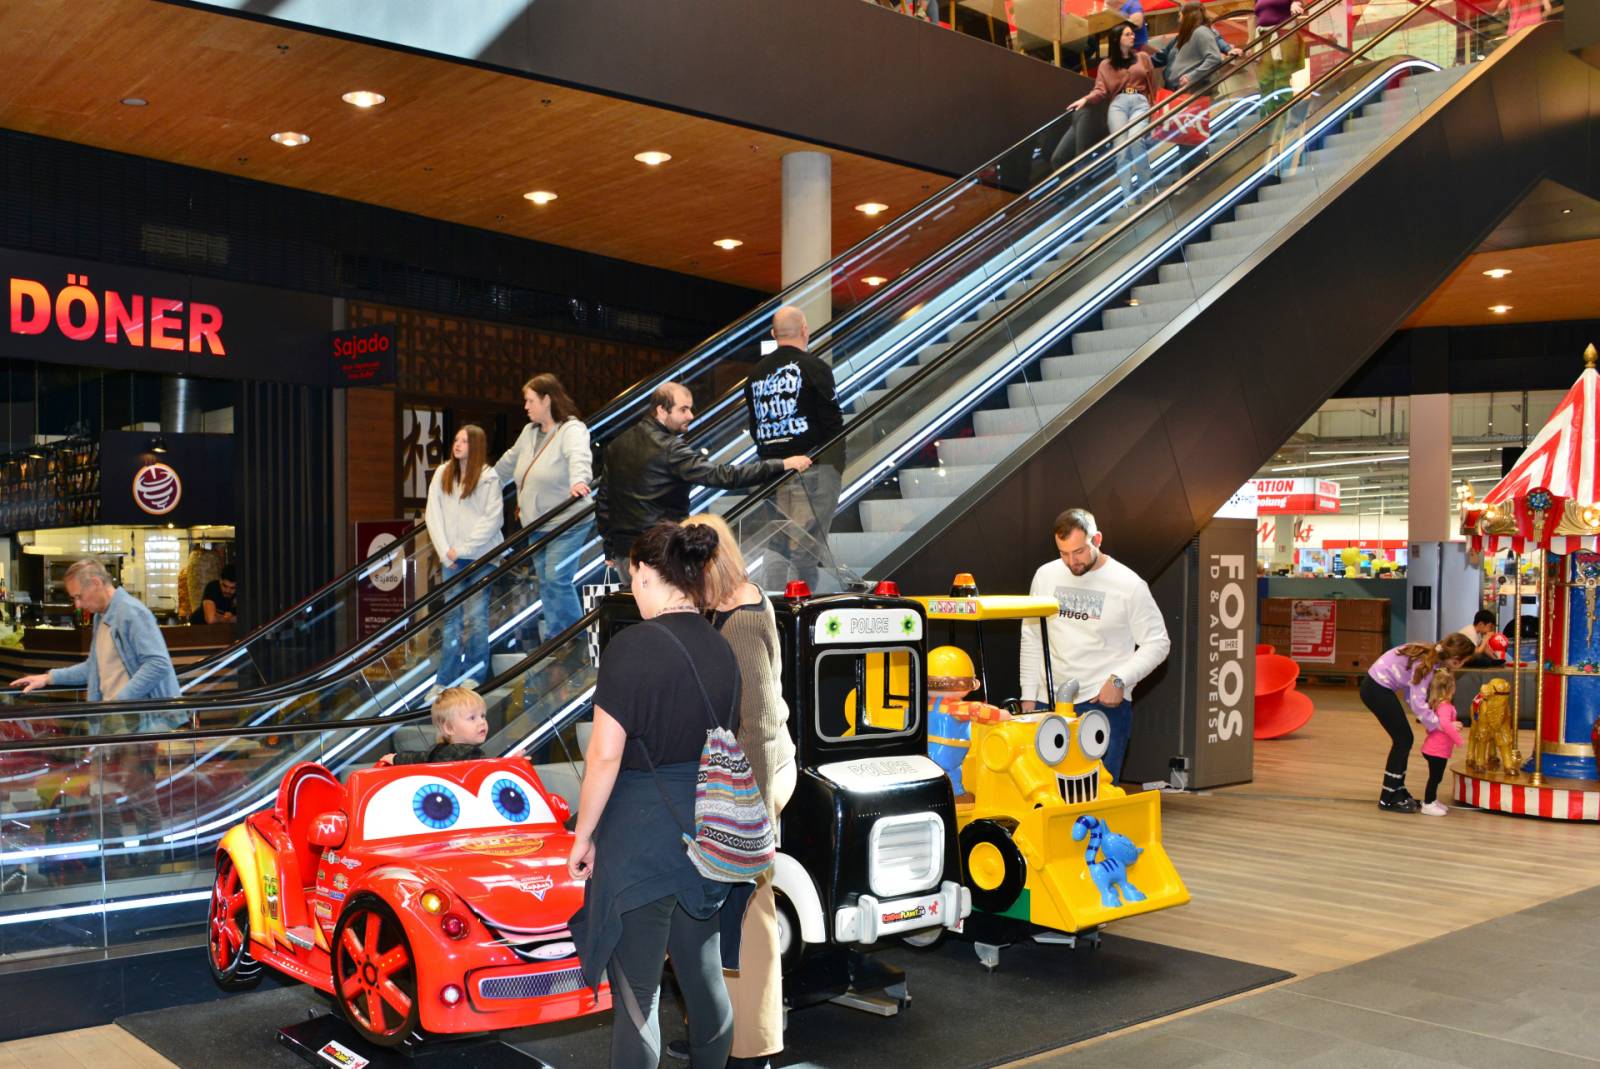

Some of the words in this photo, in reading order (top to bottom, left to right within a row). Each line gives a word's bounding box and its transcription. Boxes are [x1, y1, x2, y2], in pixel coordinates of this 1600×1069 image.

[9, 273, 227, 356] DÖNER
[333, 333, 389, 360] Sajado
[1249, 480, 1295, 493] ATION
[1210, 554, 1220, 579] ID
[1210, 590, 1220, 603] &
[850, 617, 889, 634] POLICE
[1058, 609, 1089, 621] HUGO
[1218, 554, 1245, 741] FOTOS
[1208, 614, 1219, 744] AUSWEISE
